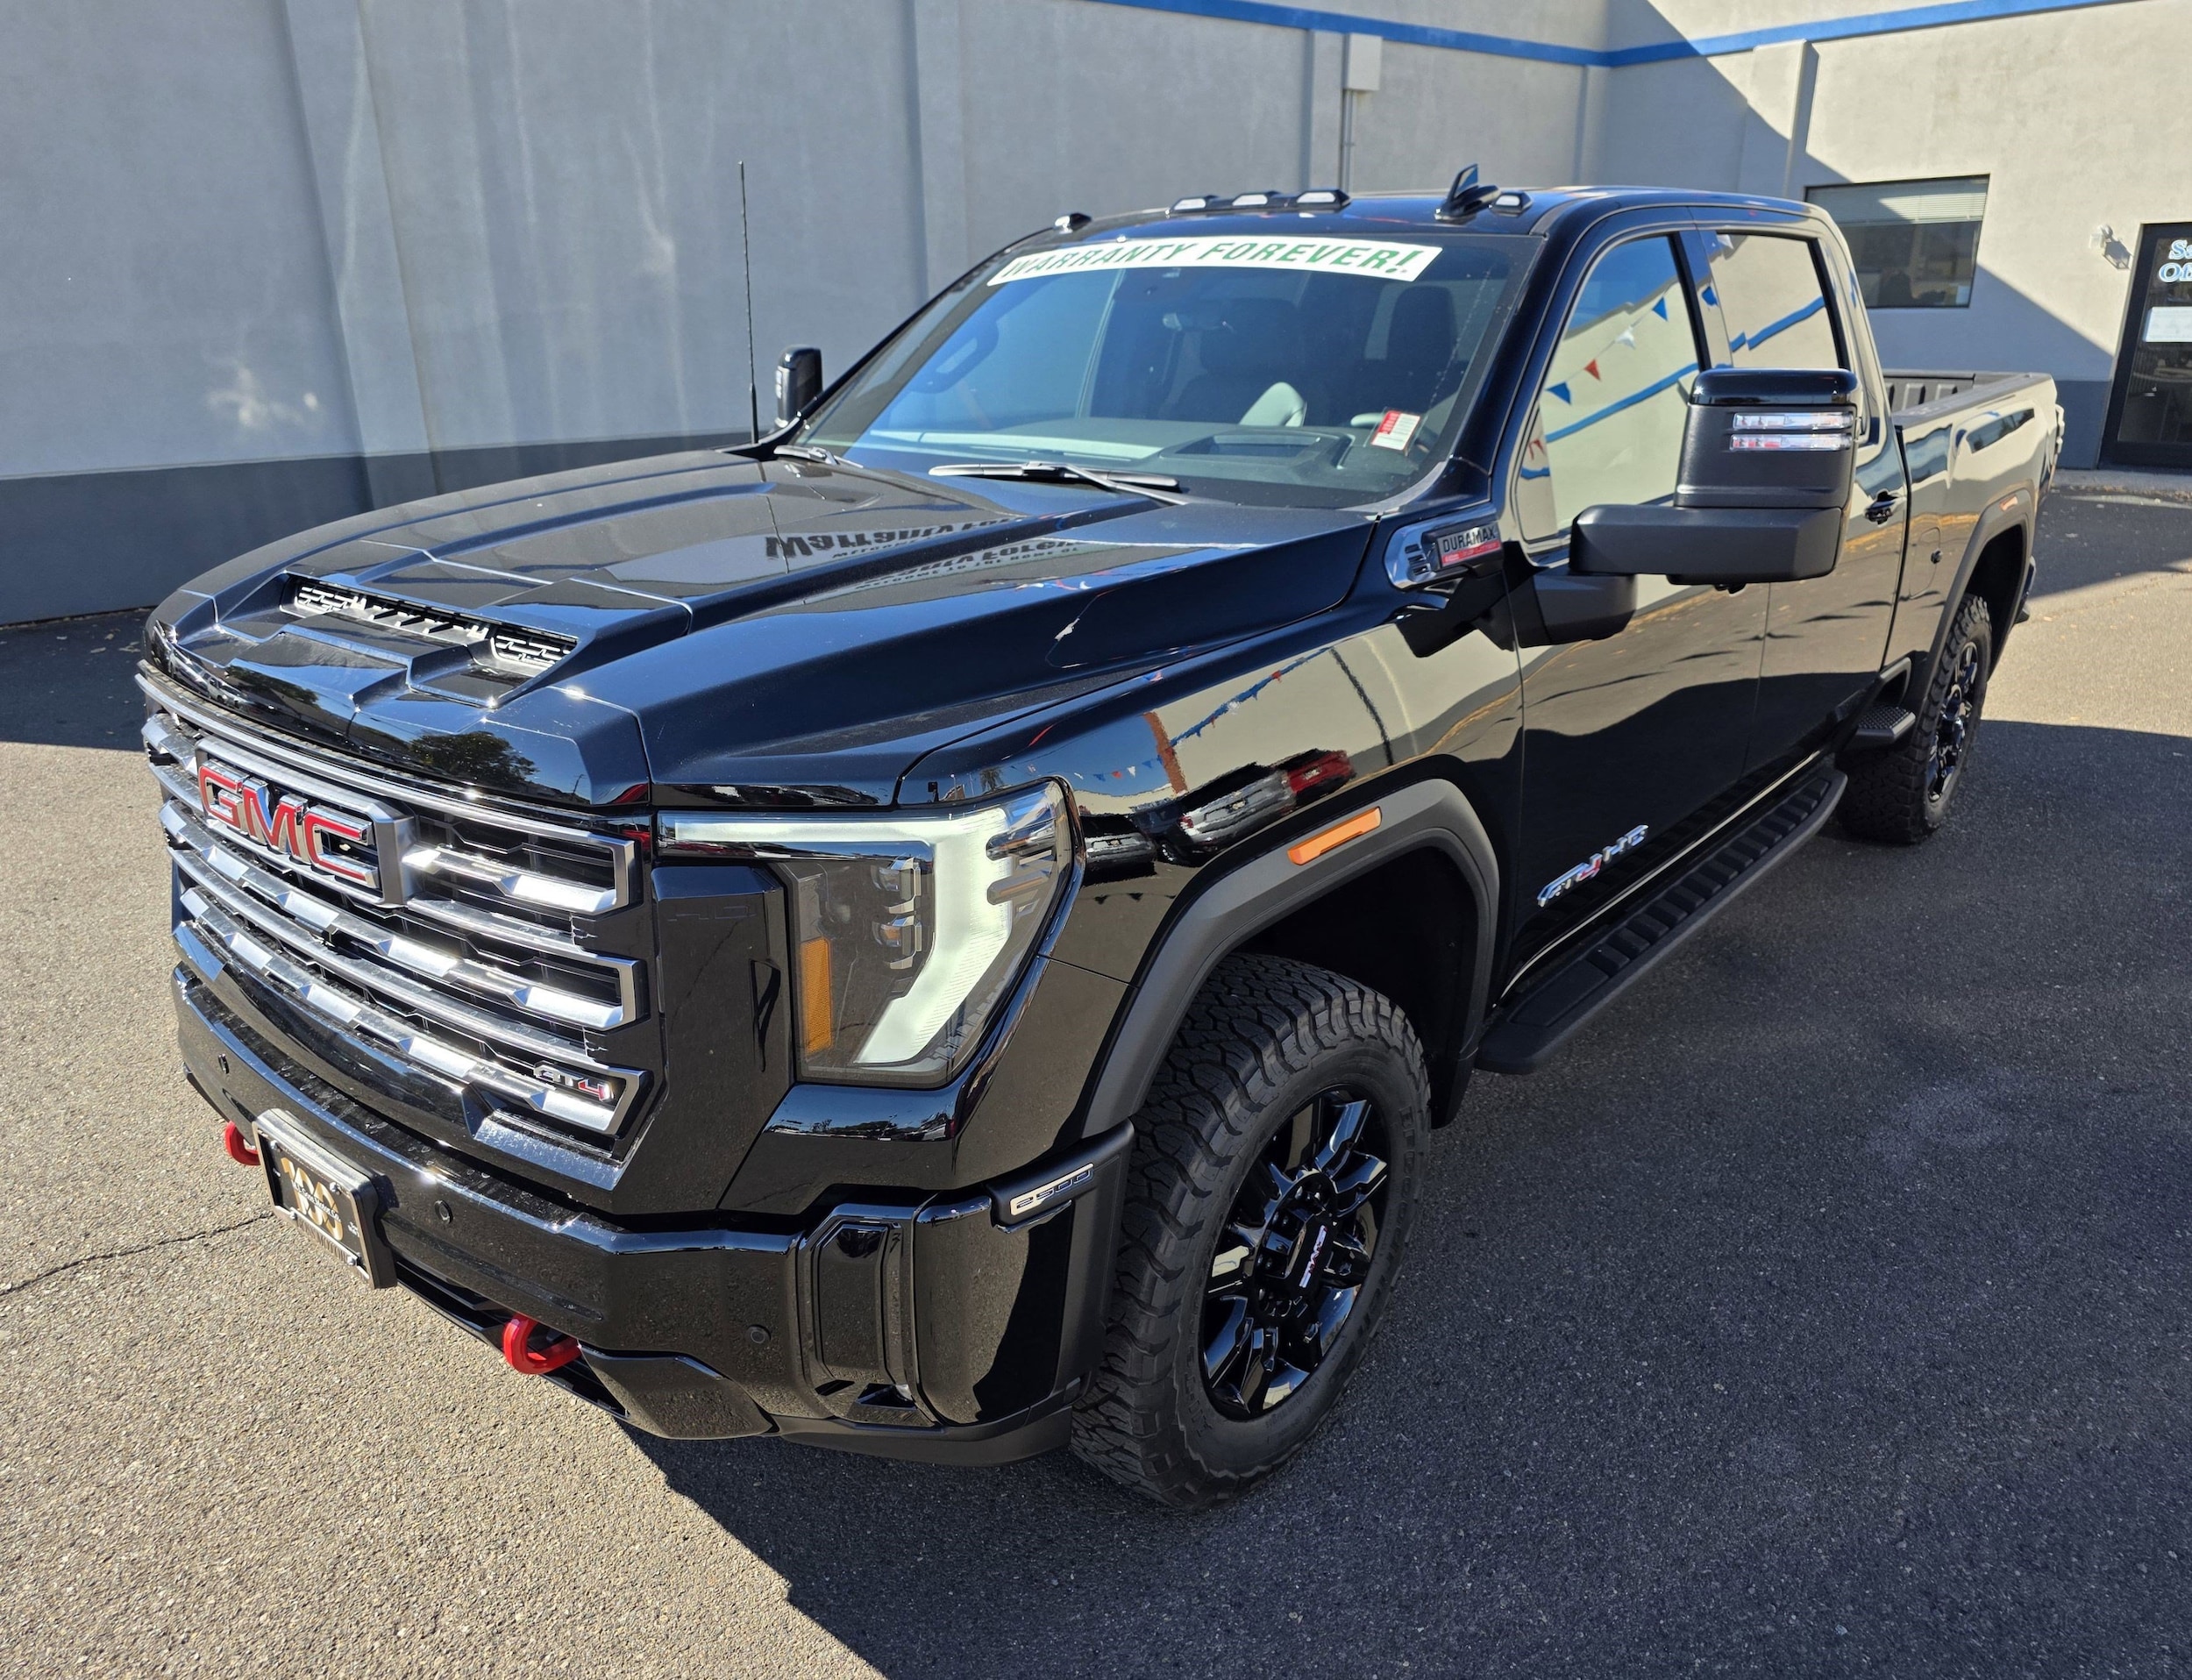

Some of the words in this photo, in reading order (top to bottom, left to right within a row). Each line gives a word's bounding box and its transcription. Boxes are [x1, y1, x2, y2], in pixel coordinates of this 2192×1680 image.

[1001, 243, 1199, 278] WARRANTY
[1196, 242, 1424, 274] FOREVER!
[1441, 526, 1496, 553] DURAMAX
[199, 759, 379, 888] GMC
[1537, 853, 1603, 907] AT4
[534, 1060, 613, 1102] AT4
[280, 1157, 344, 1242] 100
[1010, 1163, 1094, 1216] 2500
[1299, 1225, 1328, 1288] GMC
